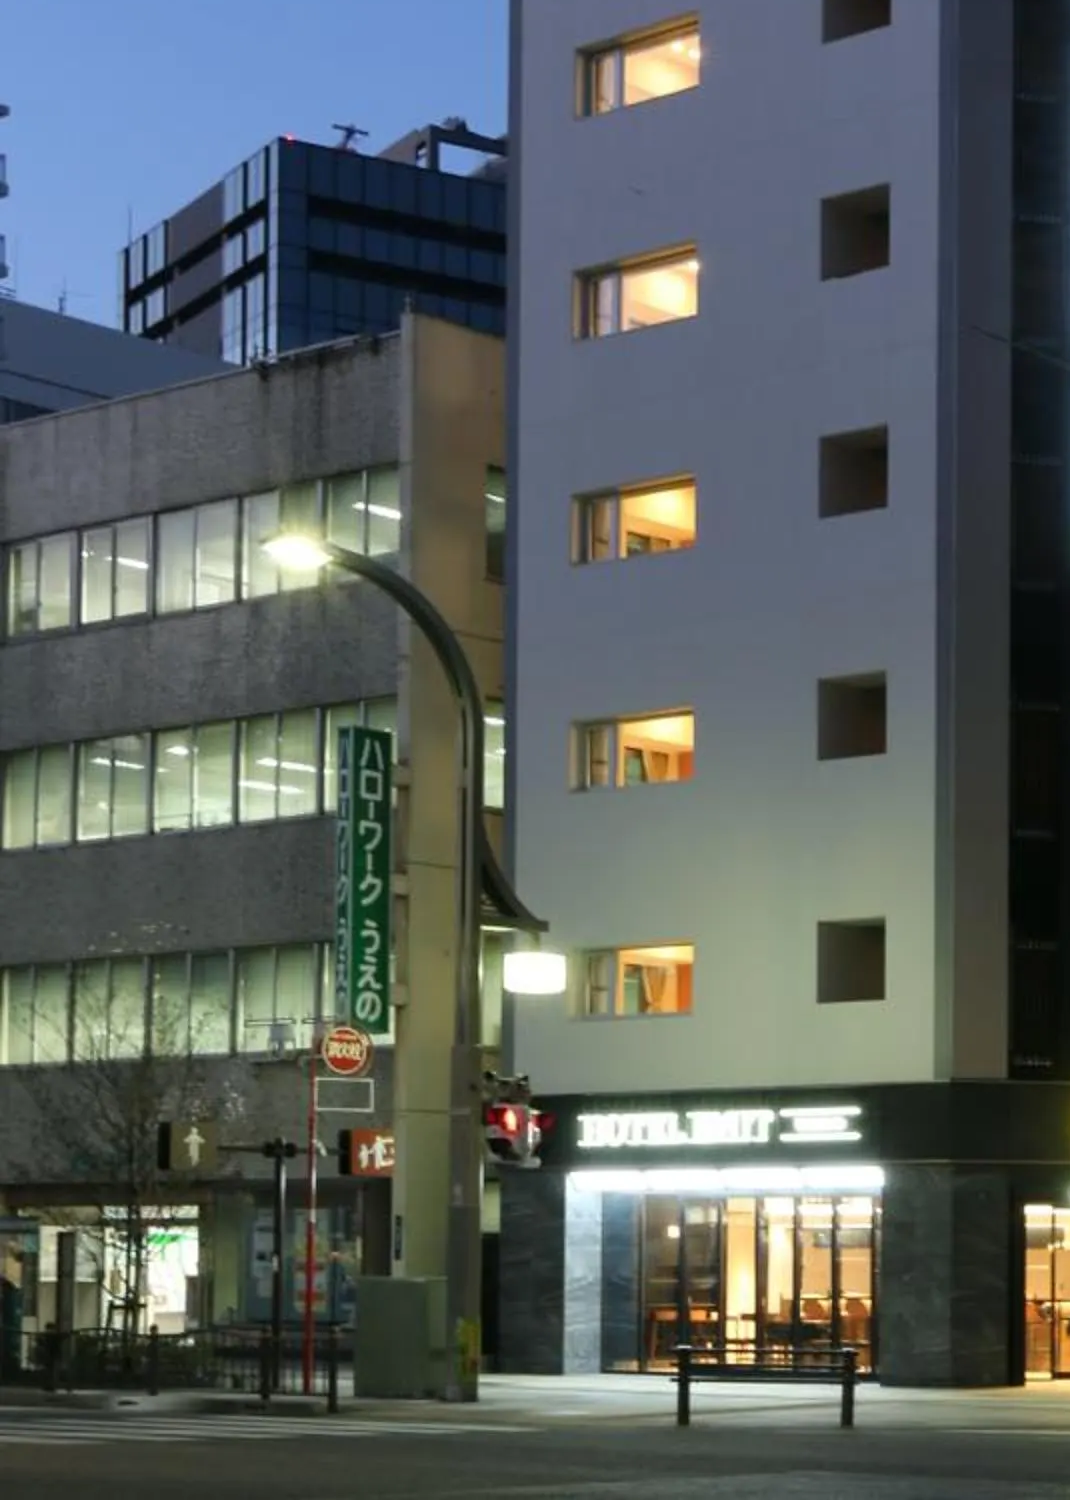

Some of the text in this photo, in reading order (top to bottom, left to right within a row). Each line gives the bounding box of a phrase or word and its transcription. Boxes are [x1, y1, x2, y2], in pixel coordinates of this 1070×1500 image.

[355, 737, 385, 1023] ハローワーク うえの
